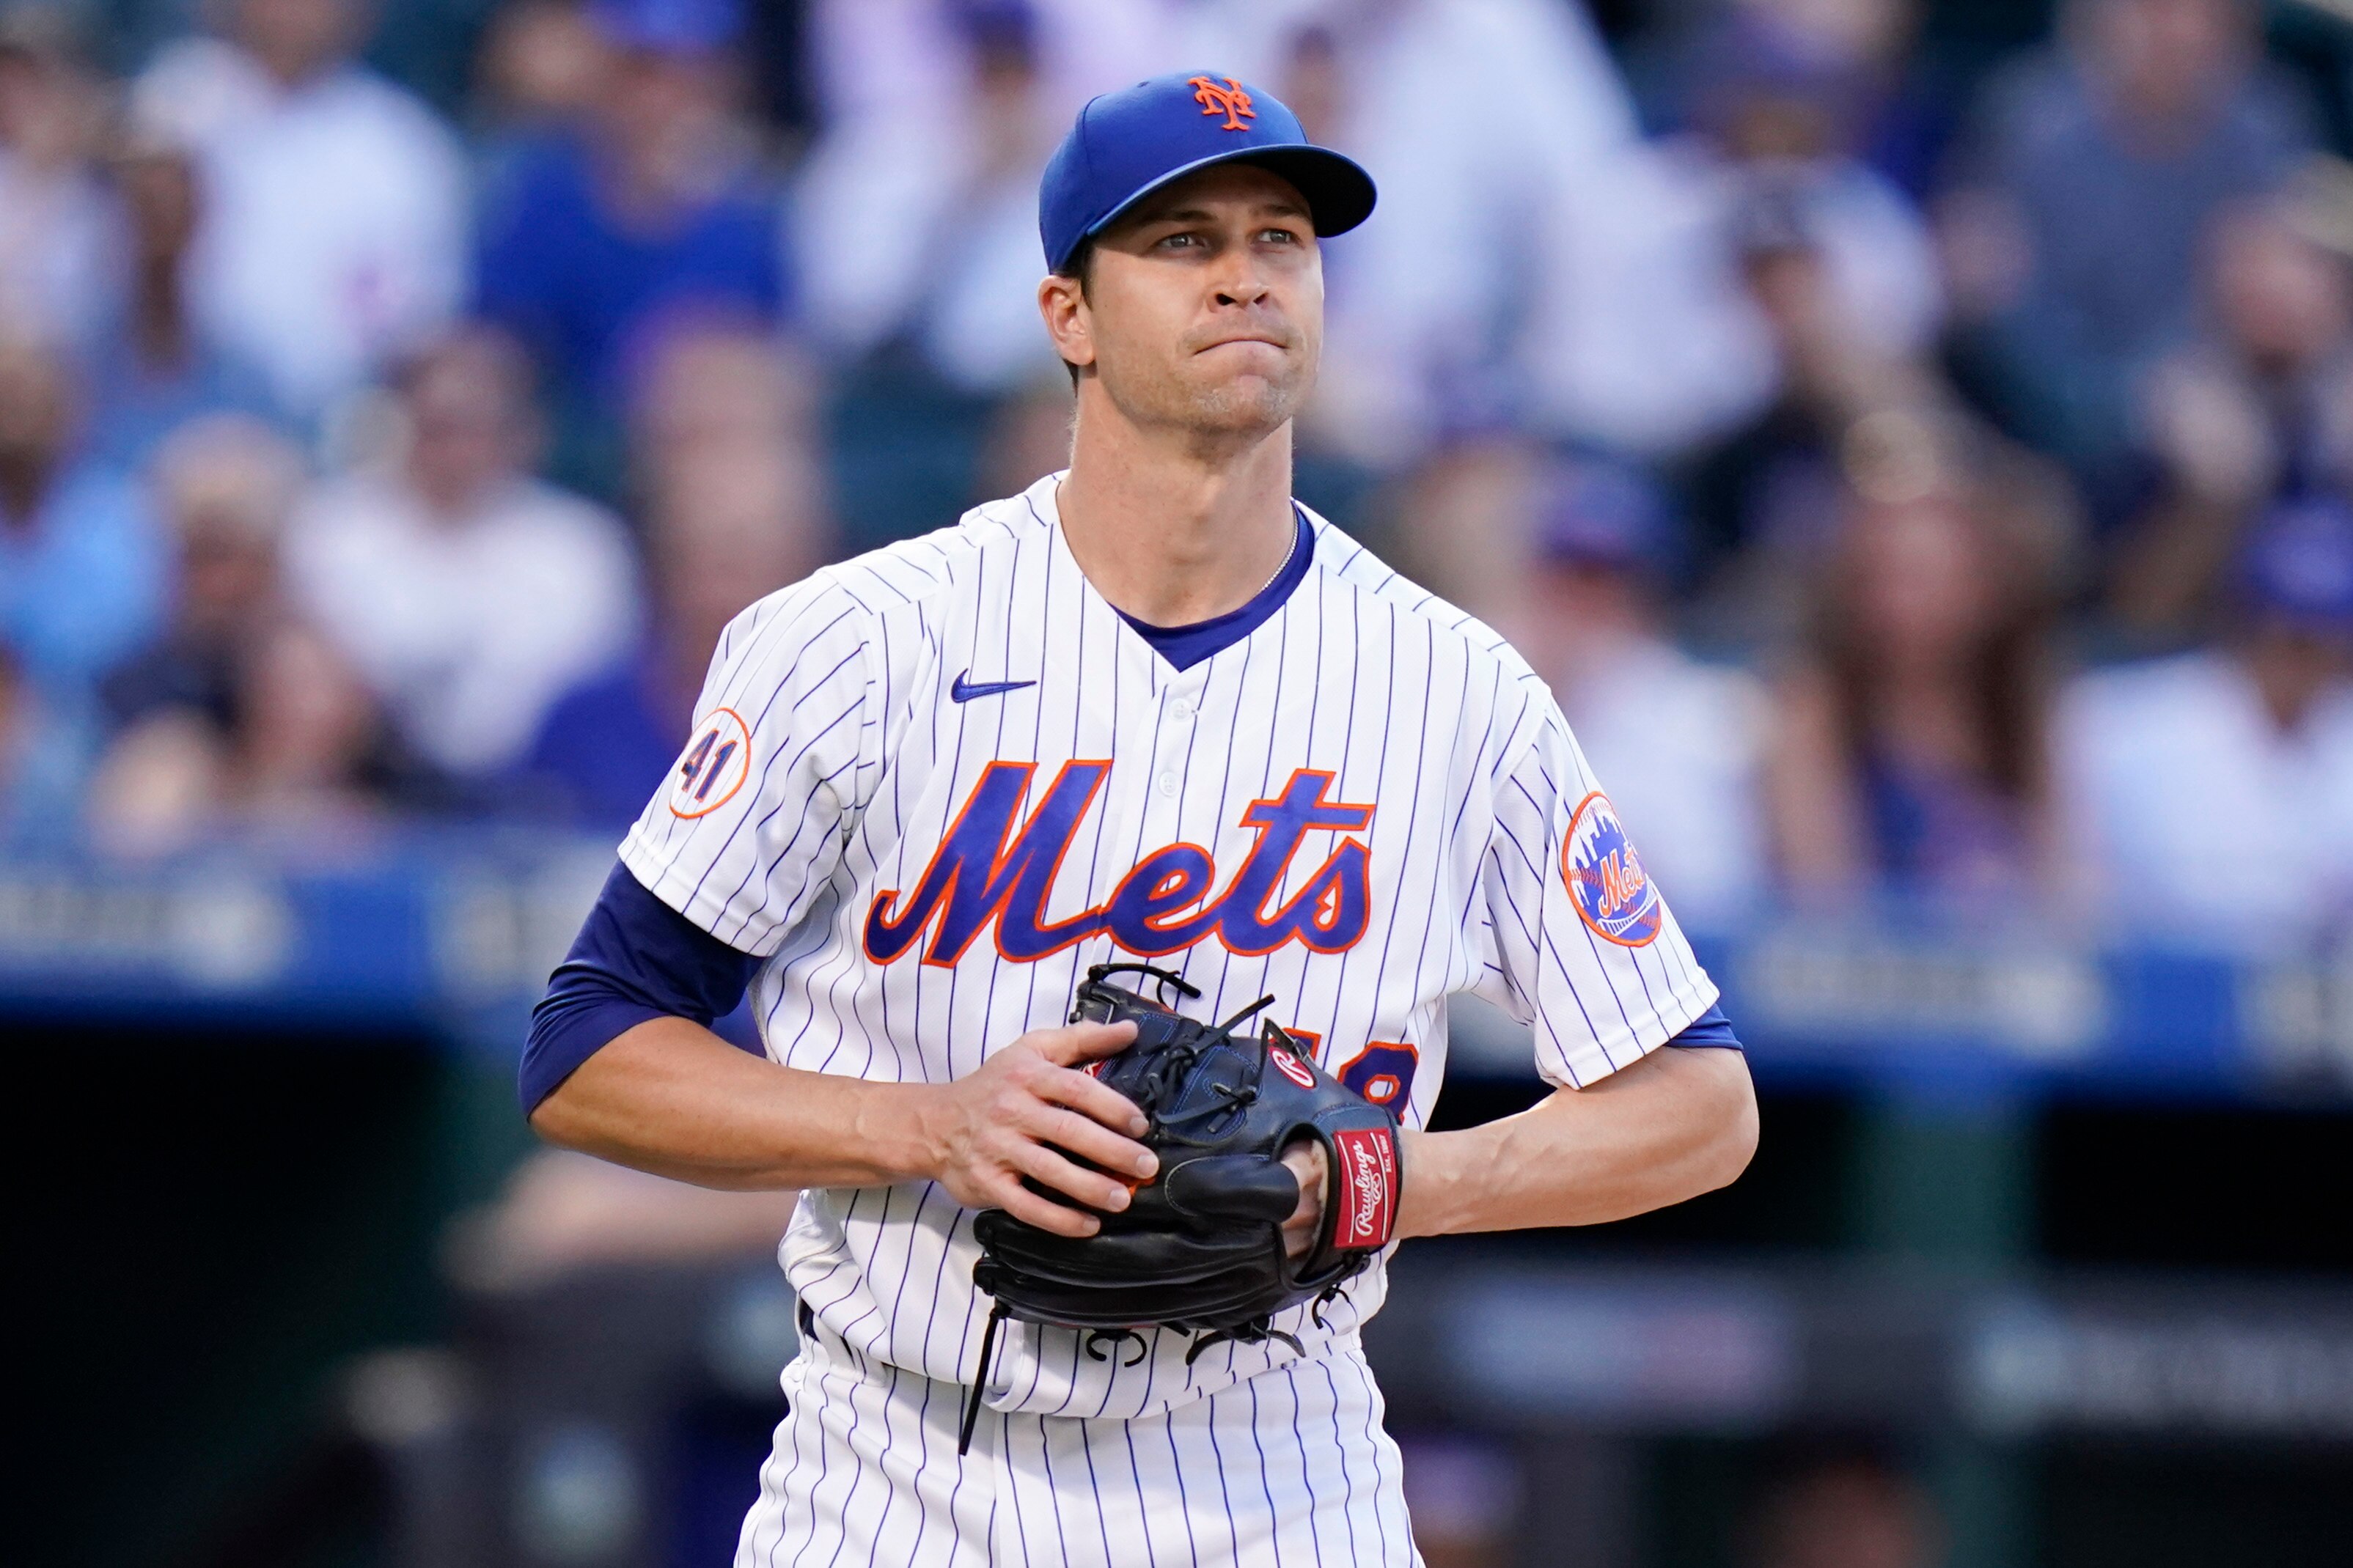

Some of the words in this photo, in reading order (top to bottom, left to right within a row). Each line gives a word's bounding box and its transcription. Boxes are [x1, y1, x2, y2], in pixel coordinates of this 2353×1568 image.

[1187, 76, 1257, 131] NY
[681, 727, 738, 803] 41
[863, 759, 1376, 968] Mets
[1352, 1140, 1377, 1237] Rawlings
